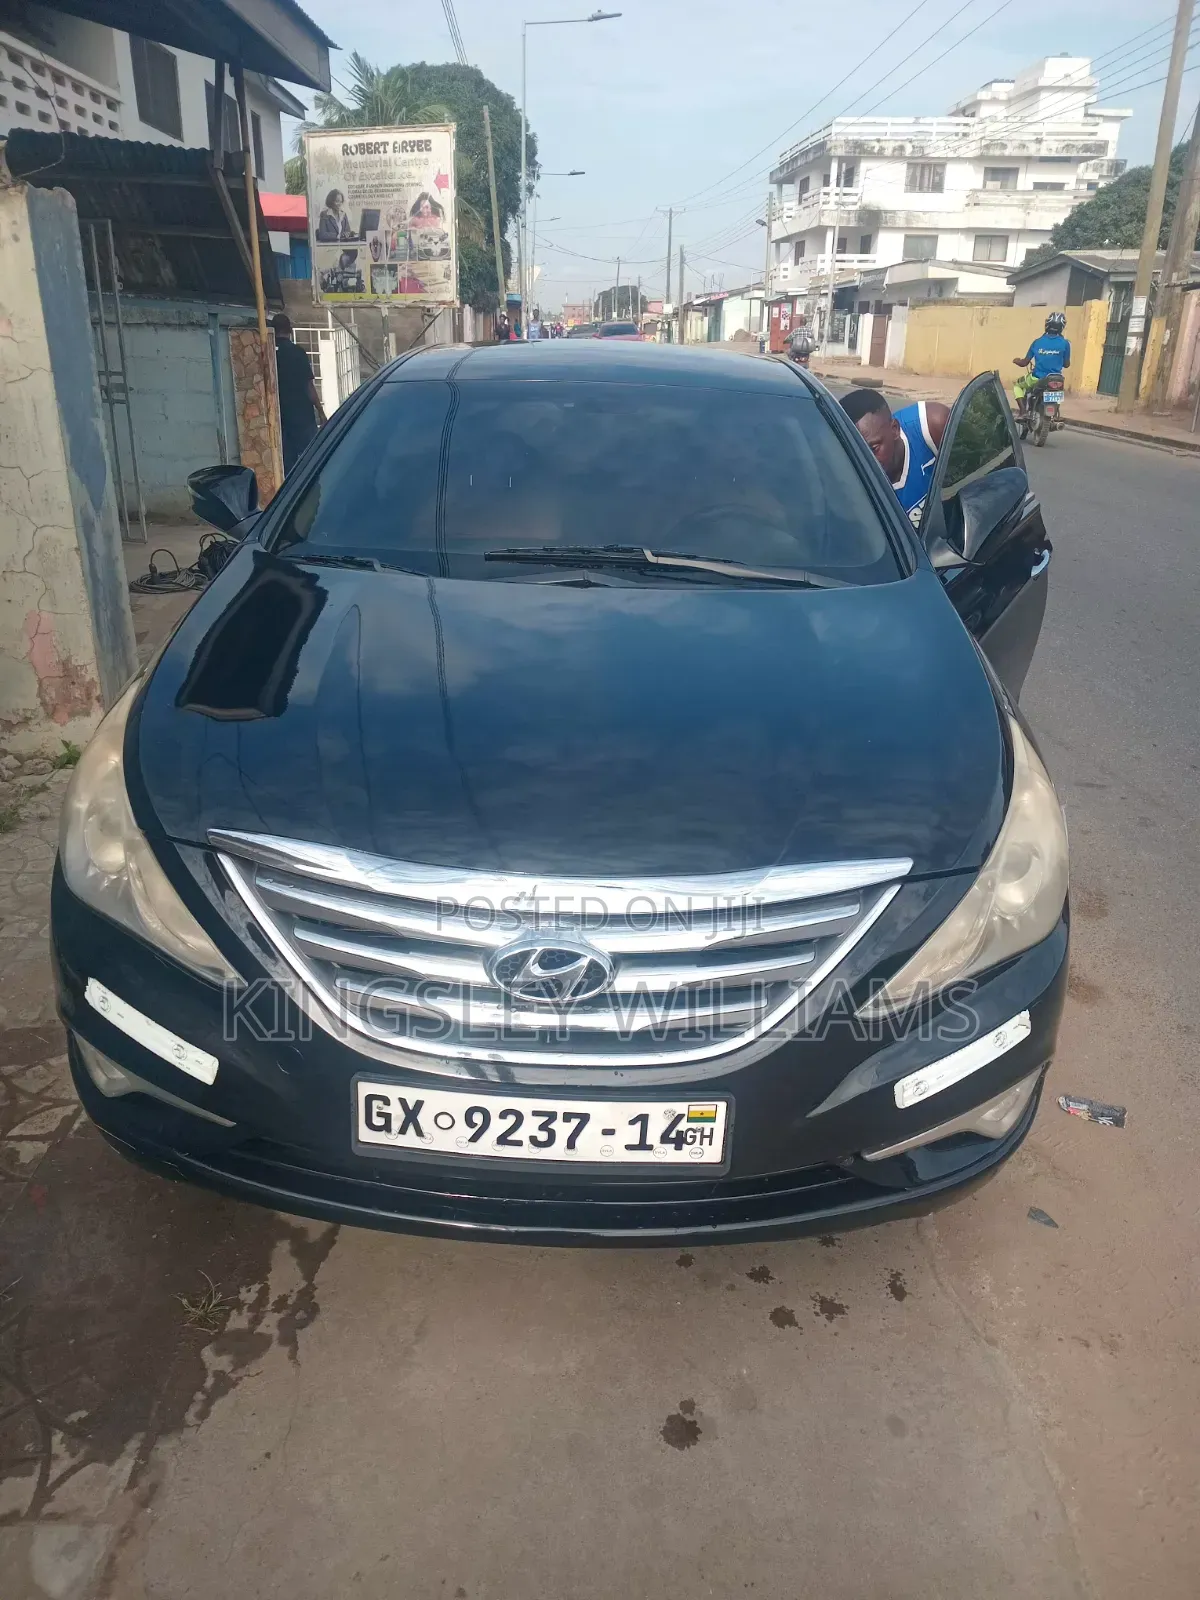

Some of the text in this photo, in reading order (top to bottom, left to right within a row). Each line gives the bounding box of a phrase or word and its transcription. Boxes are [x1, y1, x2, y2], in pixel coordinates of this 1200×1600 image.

[342, 141, 389, 156] ROBERT
[364, 1093, 425, 1138] GX
[684, 1127, 714, 1146] GH
